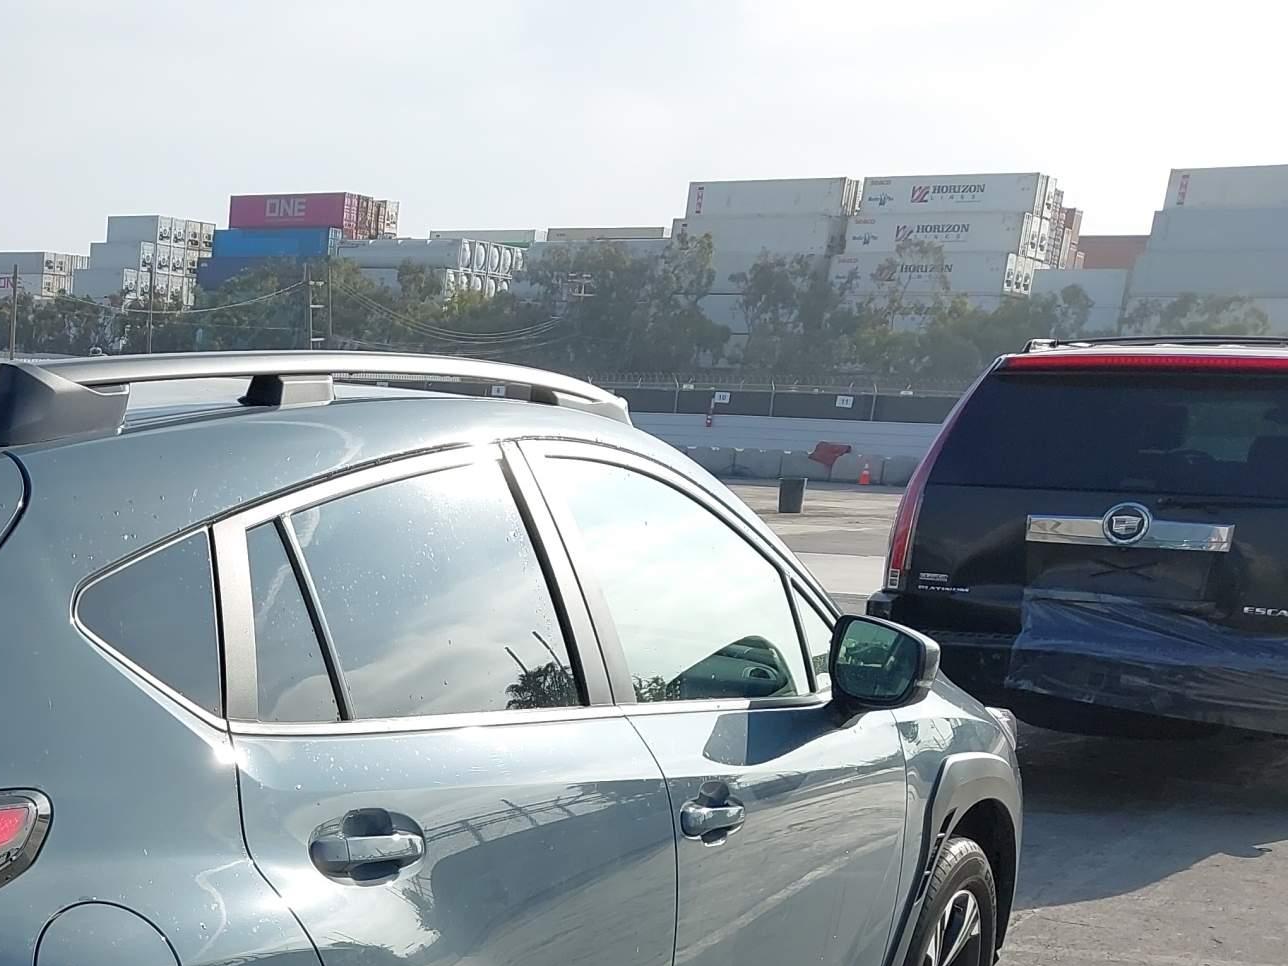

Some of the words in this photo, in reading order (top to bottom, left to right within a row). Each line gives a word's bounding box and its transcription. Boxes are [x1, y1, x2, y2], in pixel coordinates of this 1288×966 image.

[931, 184, 986, 194] HORIZON
[265, 198, 307, 217] ONE
[916, 224, 970, 233] HORIZON
